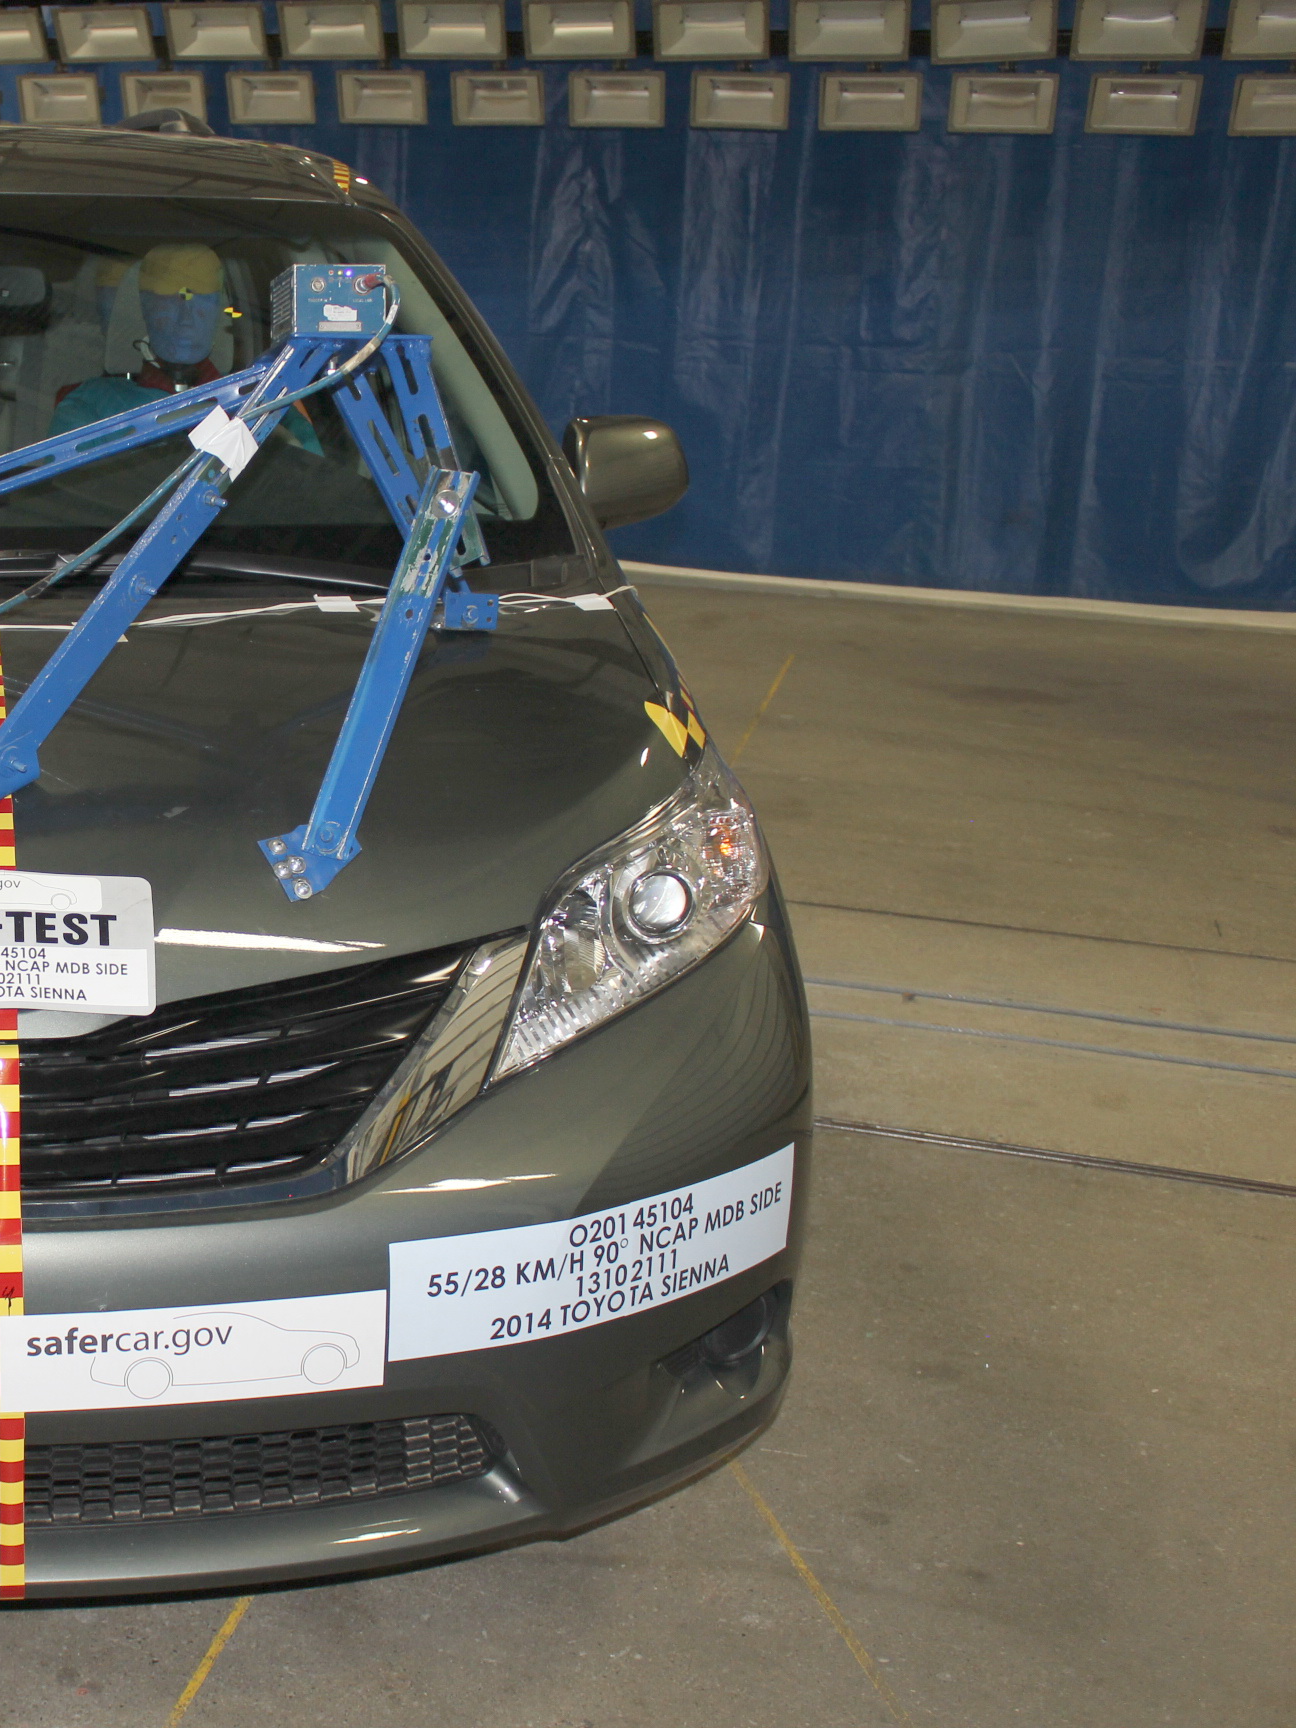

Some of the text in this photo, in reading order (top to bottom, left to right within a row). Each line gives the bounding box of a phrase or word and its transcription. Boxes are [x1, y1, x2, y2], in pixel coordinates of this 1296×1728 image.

[5, 960, 50, 972] NCAP
[56, 963, 90, 975] MDB
[96, 963, 128, 976] SIDE
[30, 987, 86, 1001] SIENNA
[427, 1182, 782, 1298] 55/28 KM/H 90° NCAP MDB SIDE
[576, 1249, 678, 1297] 13102111
[491, 1254, 729, 1340] 2014 TOYOTA SIENNA
[27, 1325, 233, 1357] safercar.gov
